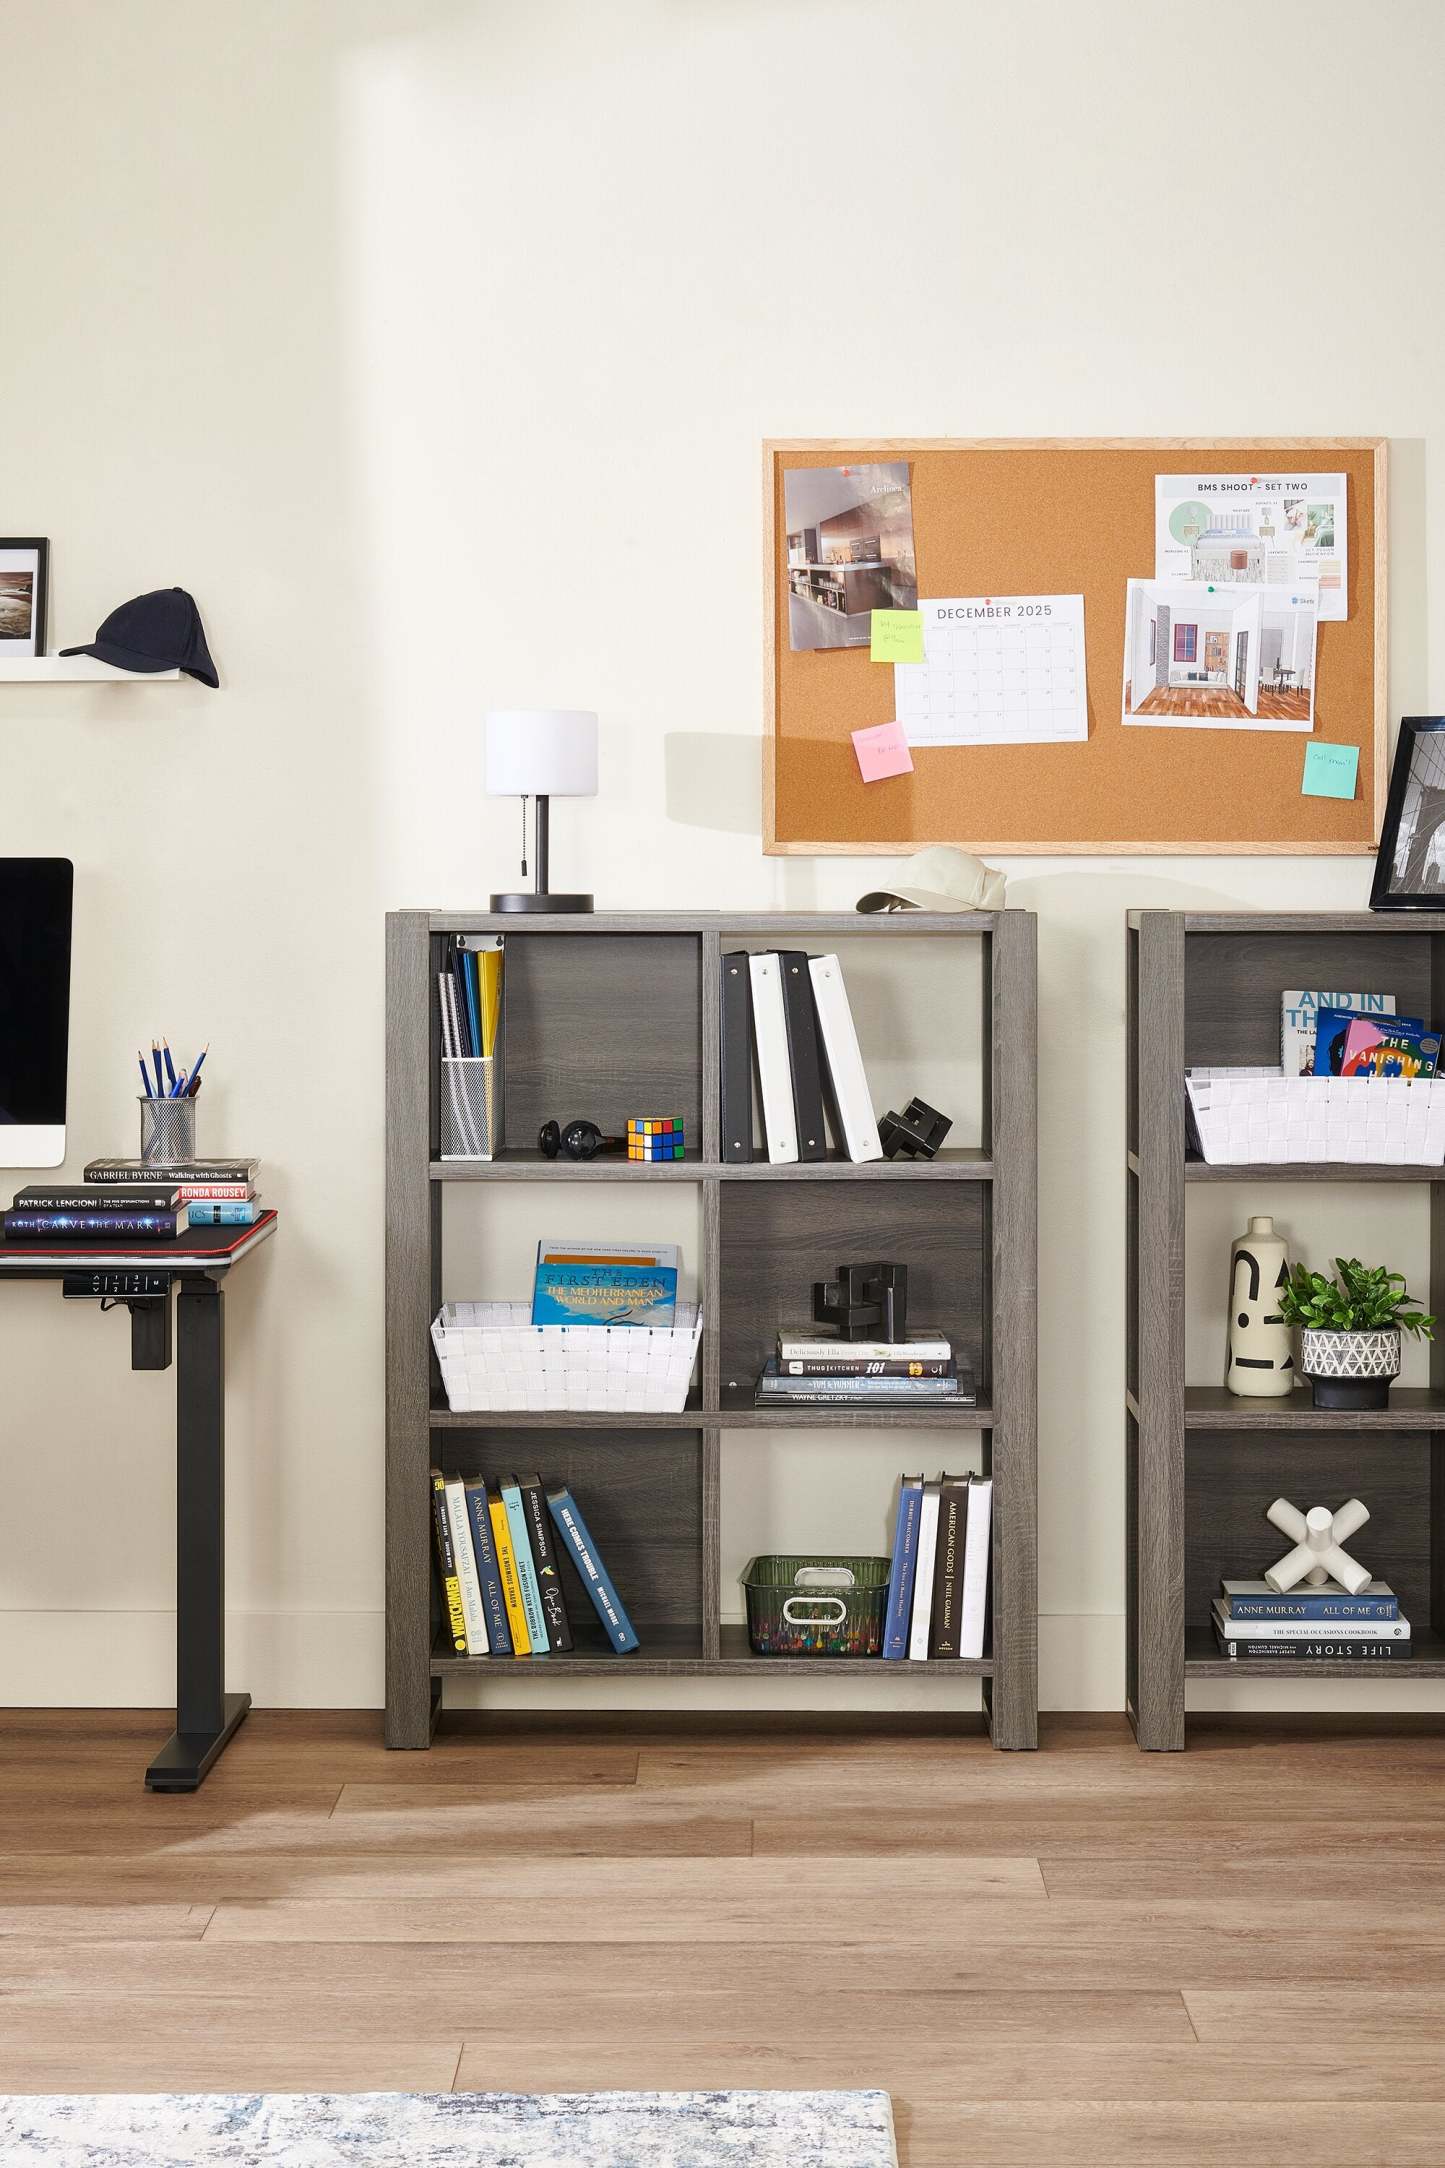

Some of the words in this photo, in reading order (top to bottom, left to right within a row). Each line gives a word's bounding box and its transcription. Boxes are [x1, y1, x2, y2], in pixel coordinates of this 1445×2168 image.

[1197, 483, 1218, 492] BMS
[1220, 483, 1253, 491] SHOOT
[1265, 483, 1282, 491] SET
[1286, 482, 1308, 490] TWO
[937, 607, 1012, 619] DECEMBER
[1017, 605, 1052, 617] 2025
[1298, 991, 1353, 1009] AND
[1360, 992, 1384, 1012] IN
[1286, 1009, 1318, 1028] TH
[1381, 1036, 1409, 1049] THE
[1349, 1051, 1434, 1072] VANISHING
[90, 1171, 130, 1179] GABRIEL
[132, 1171, 163, 1180] BYRNE
[168, 1172, 195, 1180] Walking
[181, 1187, 210, 1197] RONDA
[211, 1187, 245, 1197] ROUSEY
[19, 1200, 53, 1208] PATRICK
[56, 1200, 97, 1208] LENCIONI
[42, 1220, 86, 1229] CARVE
[91, 1220, 108, 1229] THE
[115, 1220, 153, 1230] MARK
[592, 1268, 622, 1277] THE
[545, 1274, 602, 1287] FIRST
[610, 1277, 666, 1288] EDEN
[548, 1287, 565, 1295] THE
[570, 1287, 663, 1297] MEDITERRANEAN
[555, 1296, 597, 1305] WORLD
[600, 1297, 624, 1305] AND
[627, 1298, 654, 1306] MAN
[790, 1348, 824, 1358] Deliciously
[827, 1348, 840, 1356] Ella
[865, 1362, 886, 1374] 101
[907, 1500, 915, 1521] DEBBIE
[473, 1496, 485, 1522] ANNE
[479, 1524, 492, 1563] MURRAY
[530, 1491, 541, 1522] JESSICA
[536, 1523, 547, 1557] SIMPSON
[947, 1501, 957, 1547] AMERICAN
[453, 1496, 463, 1530] MALALA
[458, 1531, 471, 1575] YOUSAFZAI
[904, 1522, 913, 1554] MACOMBER
[560, 1508, 572, 1528] HERE
[569, 1526, 585, 1551] COMES
[580, 1549, 599, 1581] TROUBLE
[518, 1560, 526, 1573] DIET
[946, 1548, 955, 1573] GODS
[503, 1557, 514, 1585] ENORMOUS
[487, 1580, 497, 1597] ALL
[521, 1573, 530, 1592] FUSION
[945, 1582, 953, 1598] NEIL
[508, 1586, 517, 1608] SHADOW
[544, 1587, 559, 1606] Open
[445, 1576, 465, 1638] WATCHMEN
[491, 1599, 500, 1612] OF
[596, 1586, 610, 1609] MICHAEL
[606, 1607, 620, 1627] MOORE
[943, 1598, 952, 1629] GAIMAN
[1237, 1606, 1263, 1614] ANNE
[1266, 1606, 1306, 1615] MURRAY
[1323, 1607, 1340, 1615] ALL
[1342, 1607, 1355, 1615] OF
[1357, 1607, 1371, 1615] ME
[493, 1614, 502, 1628] ME
[547, 1606, 562, 1626] Book
[1305, 1645, 1352, 1655] STORY
[1362, 1645, 1391, 1655] LIFE
